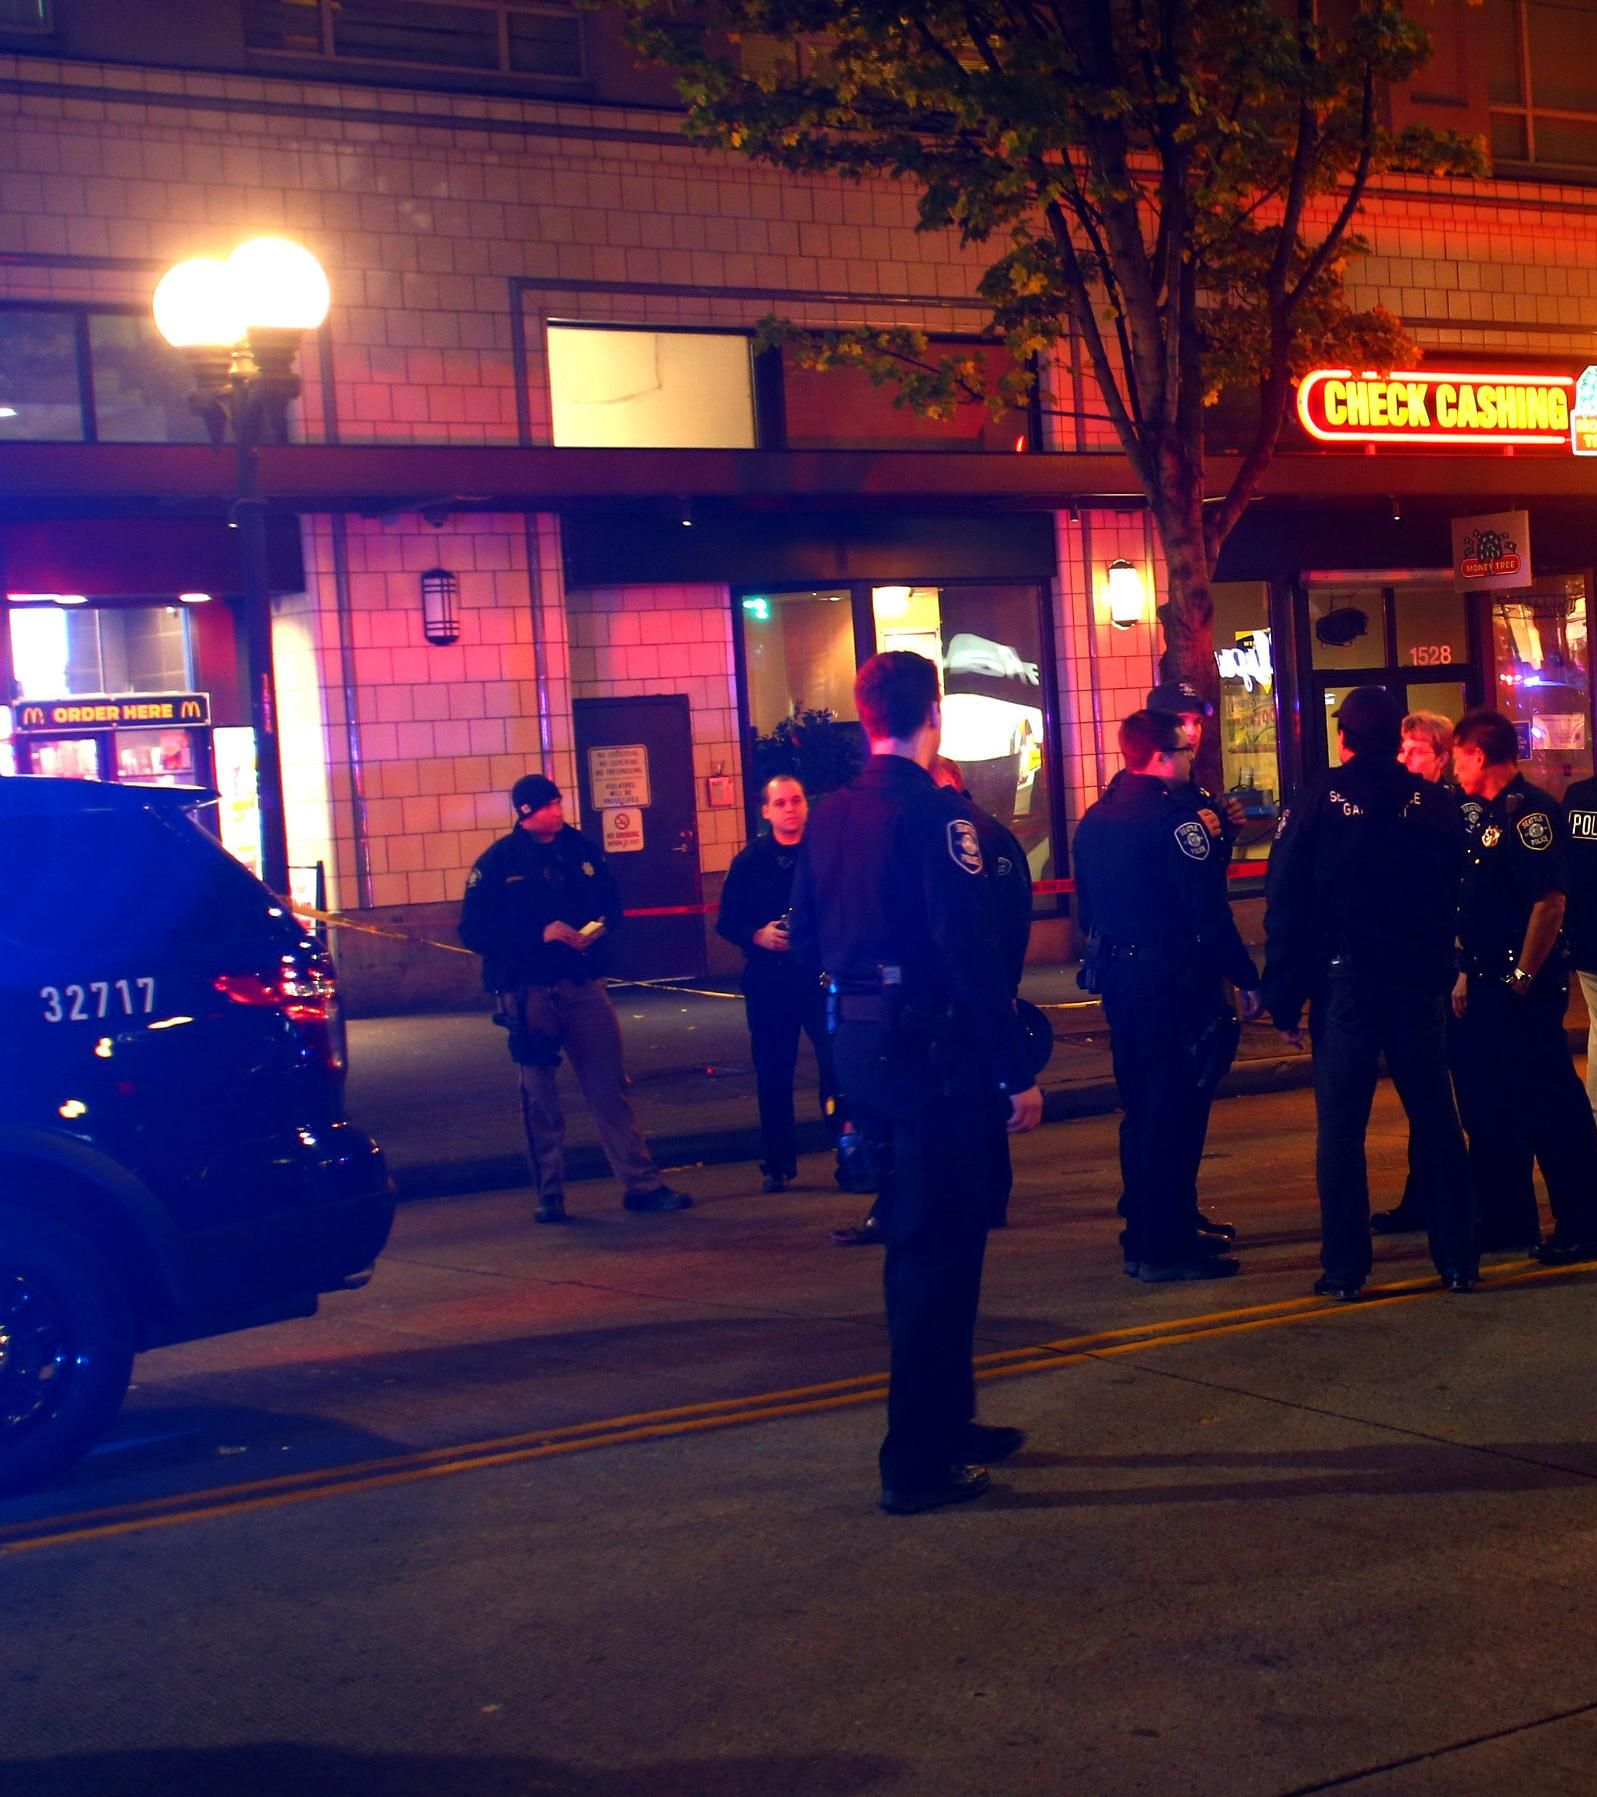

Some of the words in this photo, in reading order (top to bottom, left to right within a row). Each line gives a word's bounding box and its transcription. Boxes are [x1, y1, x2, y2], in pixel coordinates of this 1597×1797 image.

[1323, 380, 1430, 428] CHECK
[1435, 383, 1569, 430] CASHING
[1466, 562, 1493, 573] MONEY
[1495, 560, 1516, 570] TREE
[1408, 644, 1452, 667] 1528
[53, 705, 120, 723] ORDER
[123, 703, 173, 720] HERE
[40, 976, 155, 1023] 32717
